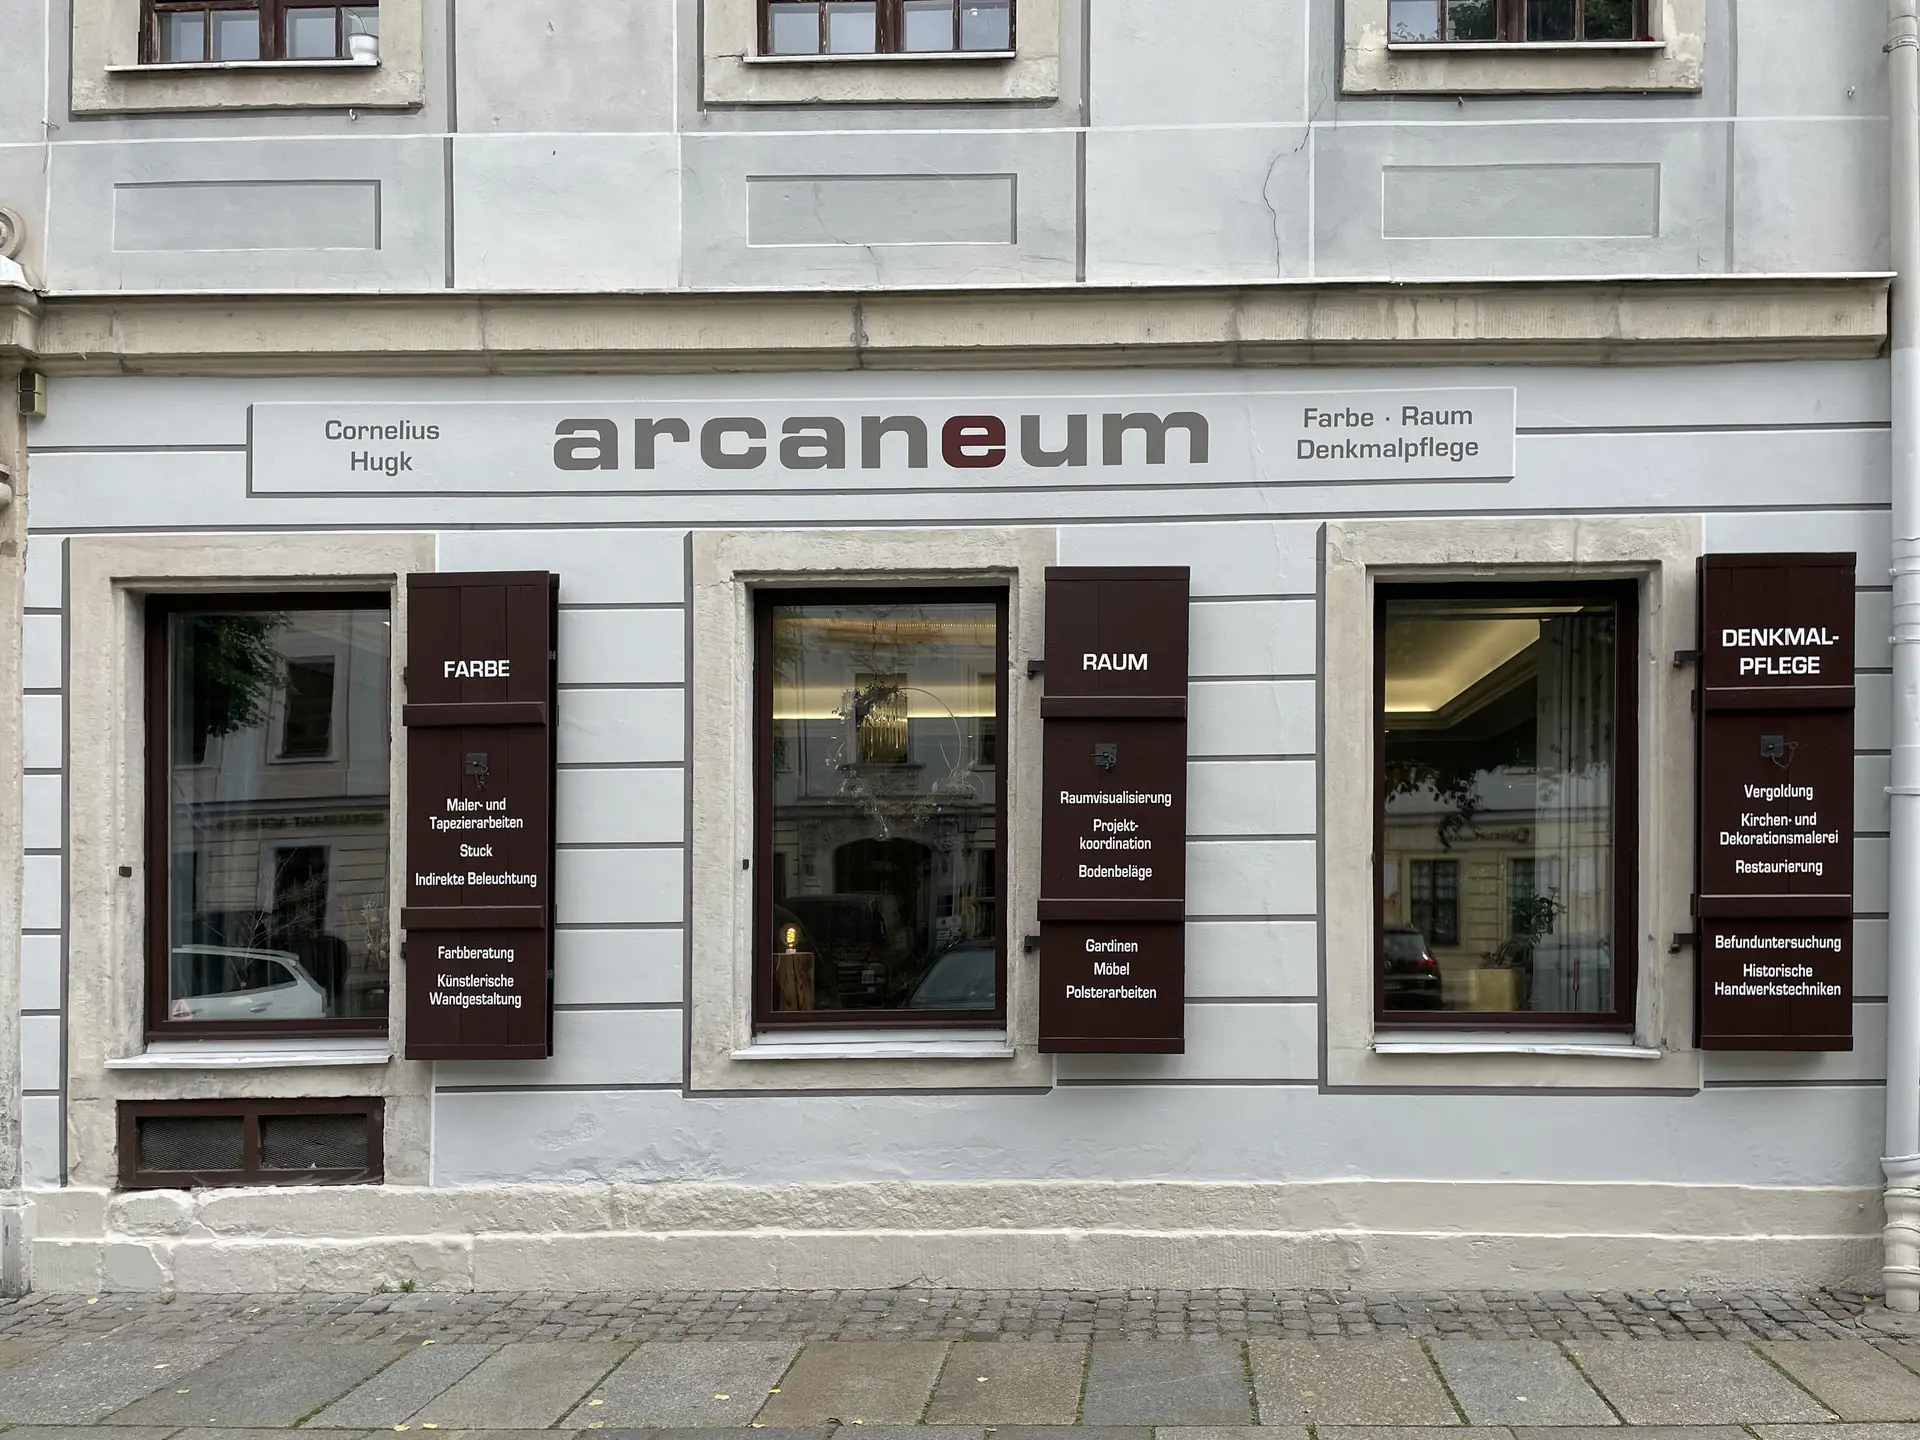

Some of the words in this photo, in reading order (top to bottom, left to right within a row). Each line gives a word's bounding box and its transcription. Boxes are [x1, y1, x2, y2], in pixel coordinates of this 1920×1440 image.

[1304, 407, 1373, 428] Farbe
[1402, 406, 1472, 425] Raum
[326, 420, 439, 439] Cornelius
[554, 412, 1208, 470] arcaneum
[1297, 437, 1478, 463] Denkmalpflege
[351, 451, 412, 476] Hugk
[1723, 627, 1839, 647] DENKMAL-
[444, 660, 509, 678] FARBE
[1083, 654, 1147, 670] RAUM
[1740, 656, 1820, 675] PFLEGE
[1061, 791, 1171, 807] Raumvisualisierung
[1744, 784, 1813, 801] Vergoldung
[447, 798, 483, 811] Maler-
[486, 798, 506, 810] und
[430, 815, 523, 832] Tapezierarbeiten
[1094, 819, 1138, 834] Projekt-
[1742, 813, 1792, 826] Kirchen-
[1795, 812, 1816, 825] und
[1080, 837, 1151, 849] koordination
[1720, 830, 1838, 845] Dekorationsmalerei
[460, 844, 492, 857] Stuck
[1079, 865, 1152, 881] Bodenbeläge
[1736, 859, 1822, 876] Restaurierung
[416, 872, 464, 885] Indirekte
[468, 871, 537, 887] Beleuchtung
[1086, 939, 1138, 952] Gardinen
[1716, 935, 1841, 952] Befunduntersuchung
[438, 946, 514, 962] Farbberatung
[1094, 962, 1129, 975] Möbel
[1744, 964, 1812, 977] Historische
[438, 974, 514, 987] Künstlerische
[1715, 982, 1841, 995] Handwerkstechniken
[1067, 985, 1156, 998] Polsterarbeiten
[429, 992, 521, 1008] Wandgestaltung
